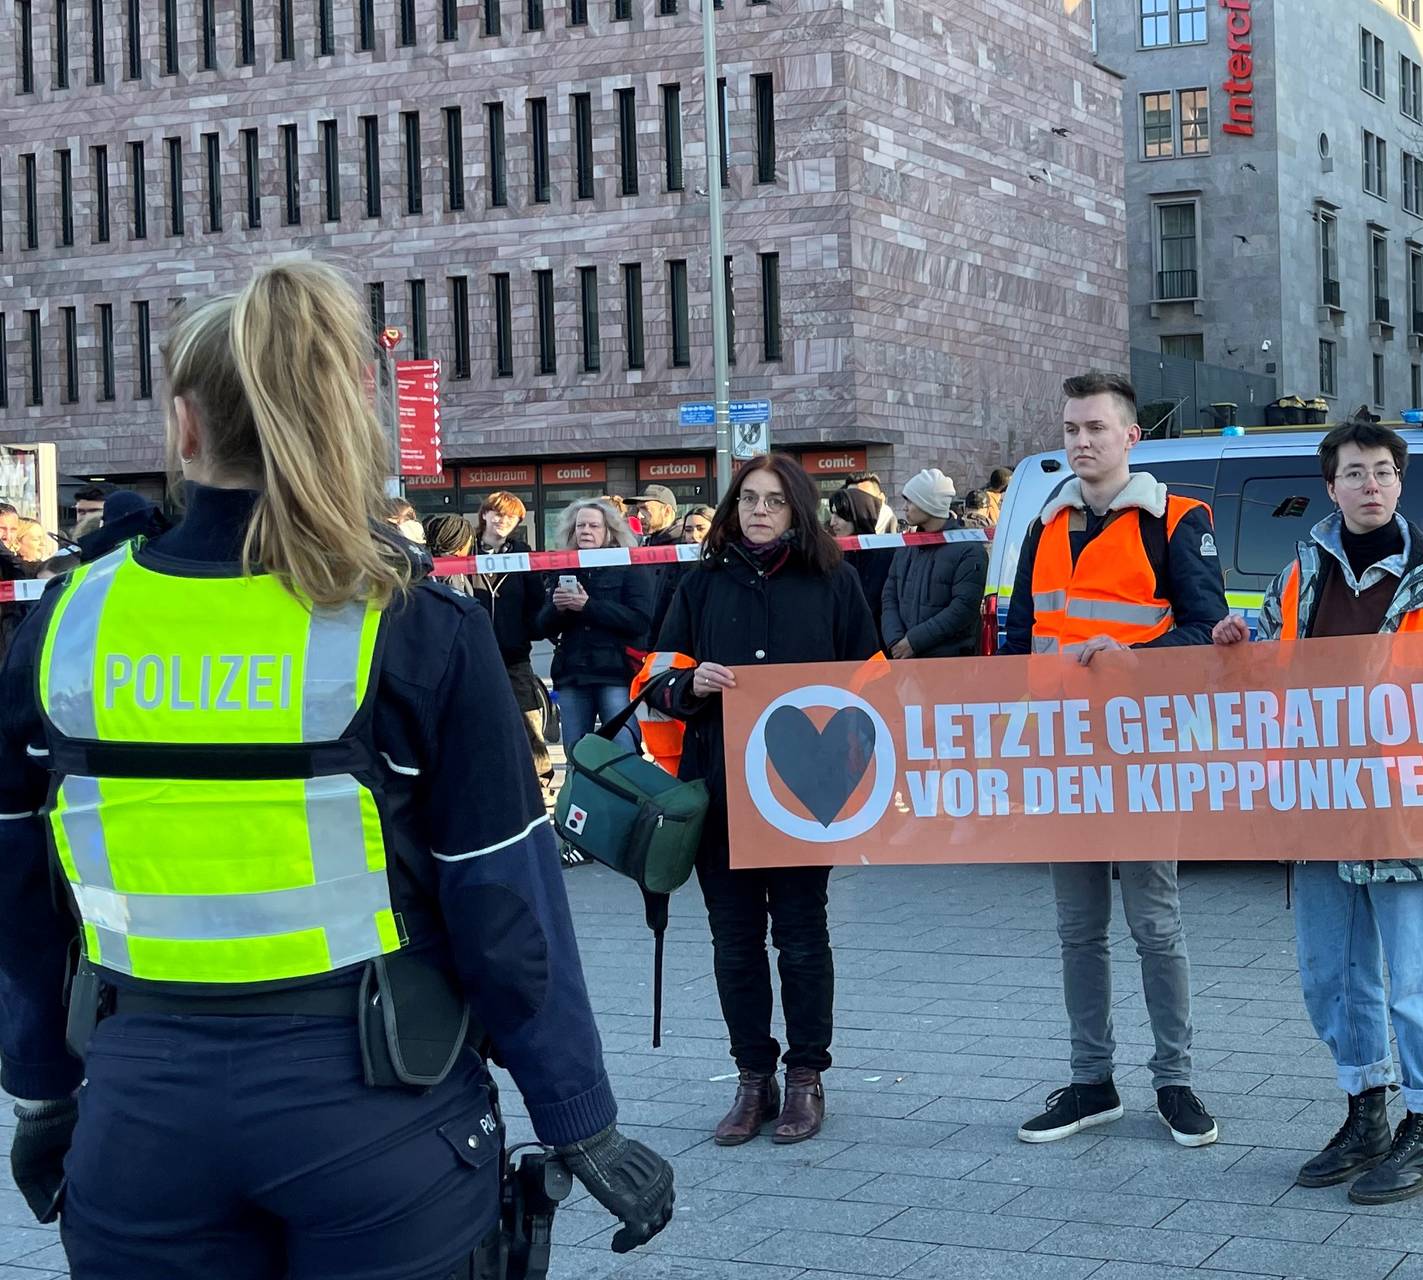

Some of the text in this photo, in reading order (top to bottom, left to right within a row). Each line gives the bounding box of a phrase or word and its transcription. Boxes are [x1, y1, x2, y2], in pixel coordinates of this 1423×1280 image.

[818, 454, 856, 469] comic
[469, 469, 527, 483] schauraum
[557, 467, 592, 480] comic
[650, 462, 697, 476] cartoon
[405, 474, 446, 485] artoon
[104, 654, 292, 711] POLIZEI
[905, 699, 1091, 761] LETZTE
[906, 767, 1011, 818] VOR
[1022, 765, 1115, 815] DEN
